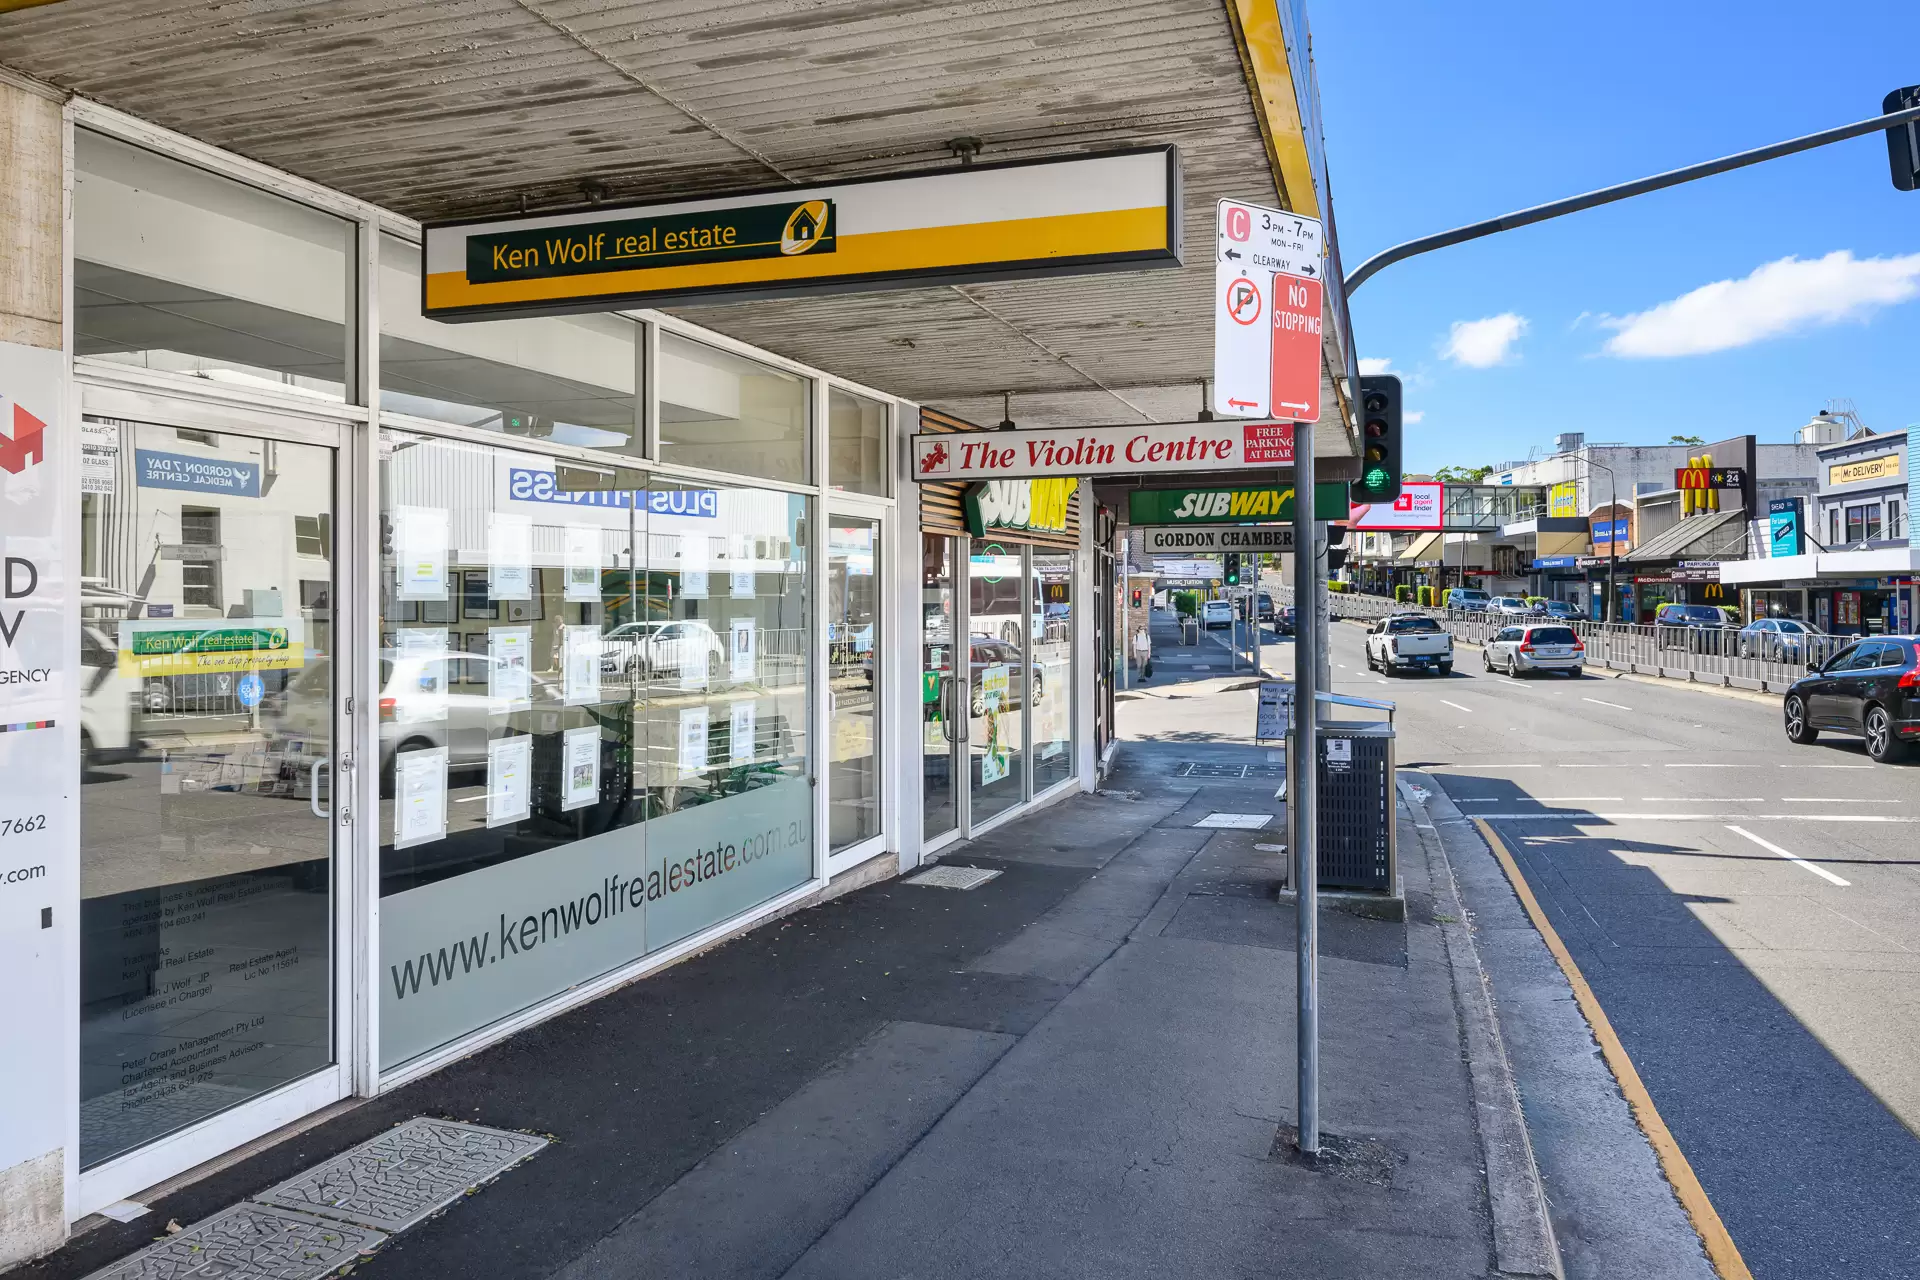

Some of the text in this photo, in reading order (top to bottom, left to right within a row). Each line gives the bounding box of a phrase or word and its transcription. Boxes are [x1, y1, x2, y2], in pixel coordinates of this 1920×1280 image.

[493, 224, 737, 270] Ken Wolf real estate
[1252, 253, 1291, 270] CLEARWAY
[1288, 284, 1308, 309] NO
[1275, 311, 1321, 335] STOPPING
[1245, 437, 1294, 449] PARKING
[1256, 427, 1284, 437] FREE
[960, 435, 1233, 470] The Violin Centre
[1249, 450, 1292, 459] AT REAR
[1726, 475, 1739, 483] 24
[1843, 469, 1851, 478] Mr
[1852, 463, 1883, 477] DELIVERY
[1174, 489, 1294, 518] SUBWAY
[1154, 531, 1293, 547] GORDON CHAMBER
[146, 634, 253, 650] Ken Wolf real estate
[197, 655, 212, 667] The
[228, 656, 240, 668] stop
[243, 655, 273, 668] property
[1, 814, 46, 837] 7662
[0, 865, 46, 885] .com
[122, 909, 163, 928] operated
[165, 905, 176, 917] by
[177, 901, 195, 913] Ken
[197, 895, 216, 909] Wolf
[217, 891, 236, 903] Real
[238, 885, 262, 899] Estate
[390, 818, 807, 1001] www.kenwolfrealestate.com.au
[122, 968, 141, 981] Ken
[166, 956, 186, 969] Real
[188, 947, 215, 962] Estate
[229, 945, 298, 974] Real Estate Agent
[171, 977, 191, 991] Wolf
[198, 971, 210, 985] JP
[244, 970, 256, 981] Lic
[258, 967, 269, 977] No
[122, 999, 166, 1022] (Licensee
[179, 983, 213, 1002] Charge)
[122, 1015, 265, 1072] Peter Crane Management Pty Ltd
[122, 1044, 219, 1085] Chartered Accountant
[123, 1041, 264, 1098] Tax Agent and Business Advisors
[121, 1094, 152, 1112] Phone
